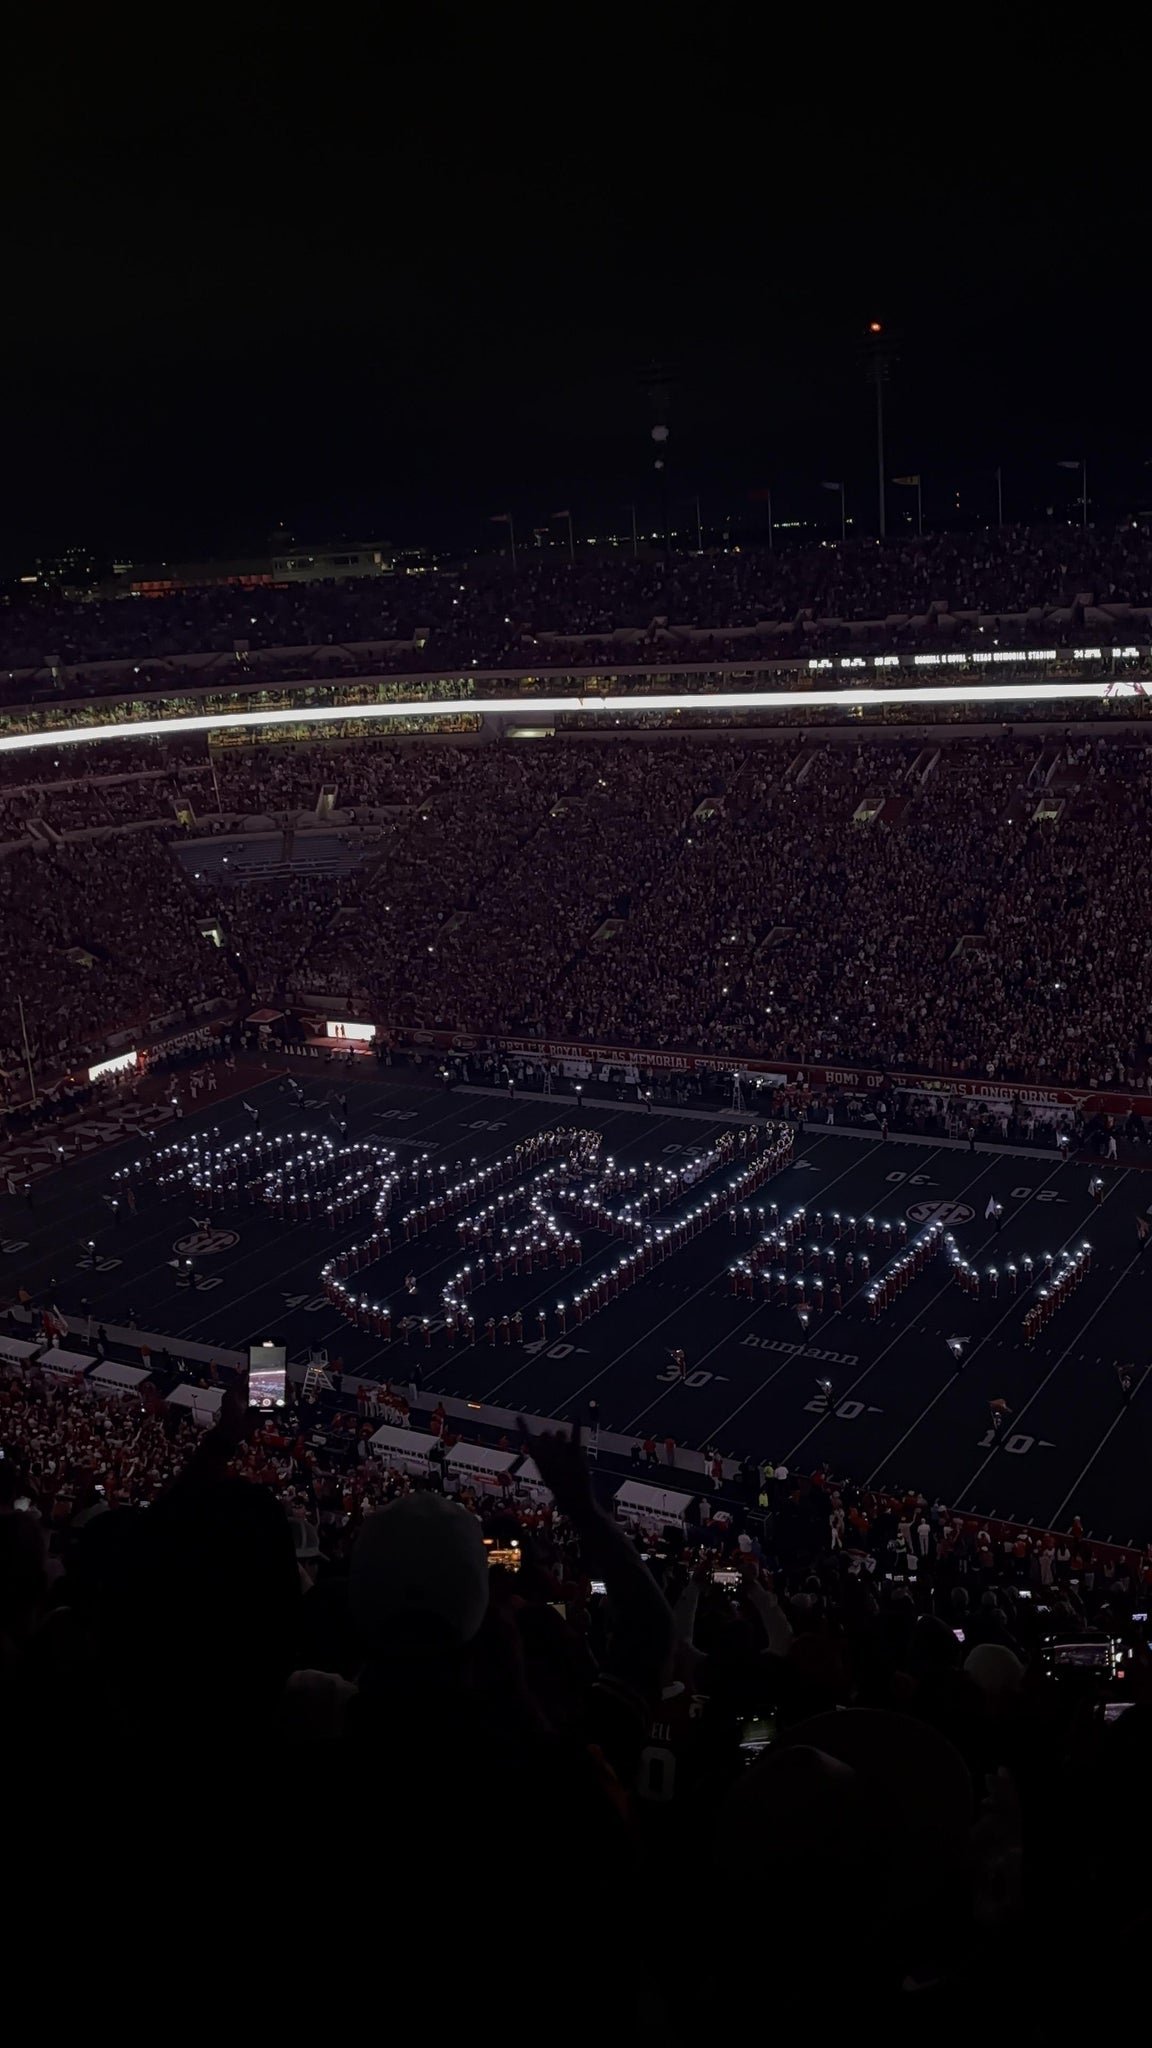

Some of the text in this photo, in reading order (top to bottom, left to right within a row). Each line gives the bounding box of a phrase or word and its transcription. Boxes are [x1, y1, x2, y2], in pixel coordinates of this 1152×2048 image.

[972, 652, 992, 662] TEXAS
[1027, 650, 1057, 661] STADIUM
[628, 1051, 693, 1070] MEMORIAL
[884, 1171, 934, 1187] 30
[1009, 1186, 1060, 1203] 20
[909, 1202, 974, 1226] SEC
[522, 1338, 577, 1360] 40
[742, 1332, 860, 1366] humann
[655, 1363, 714, 1388] 30
[802, 1394, 867, 1420] 20
[975, 1428, 1036, 1455] 10
